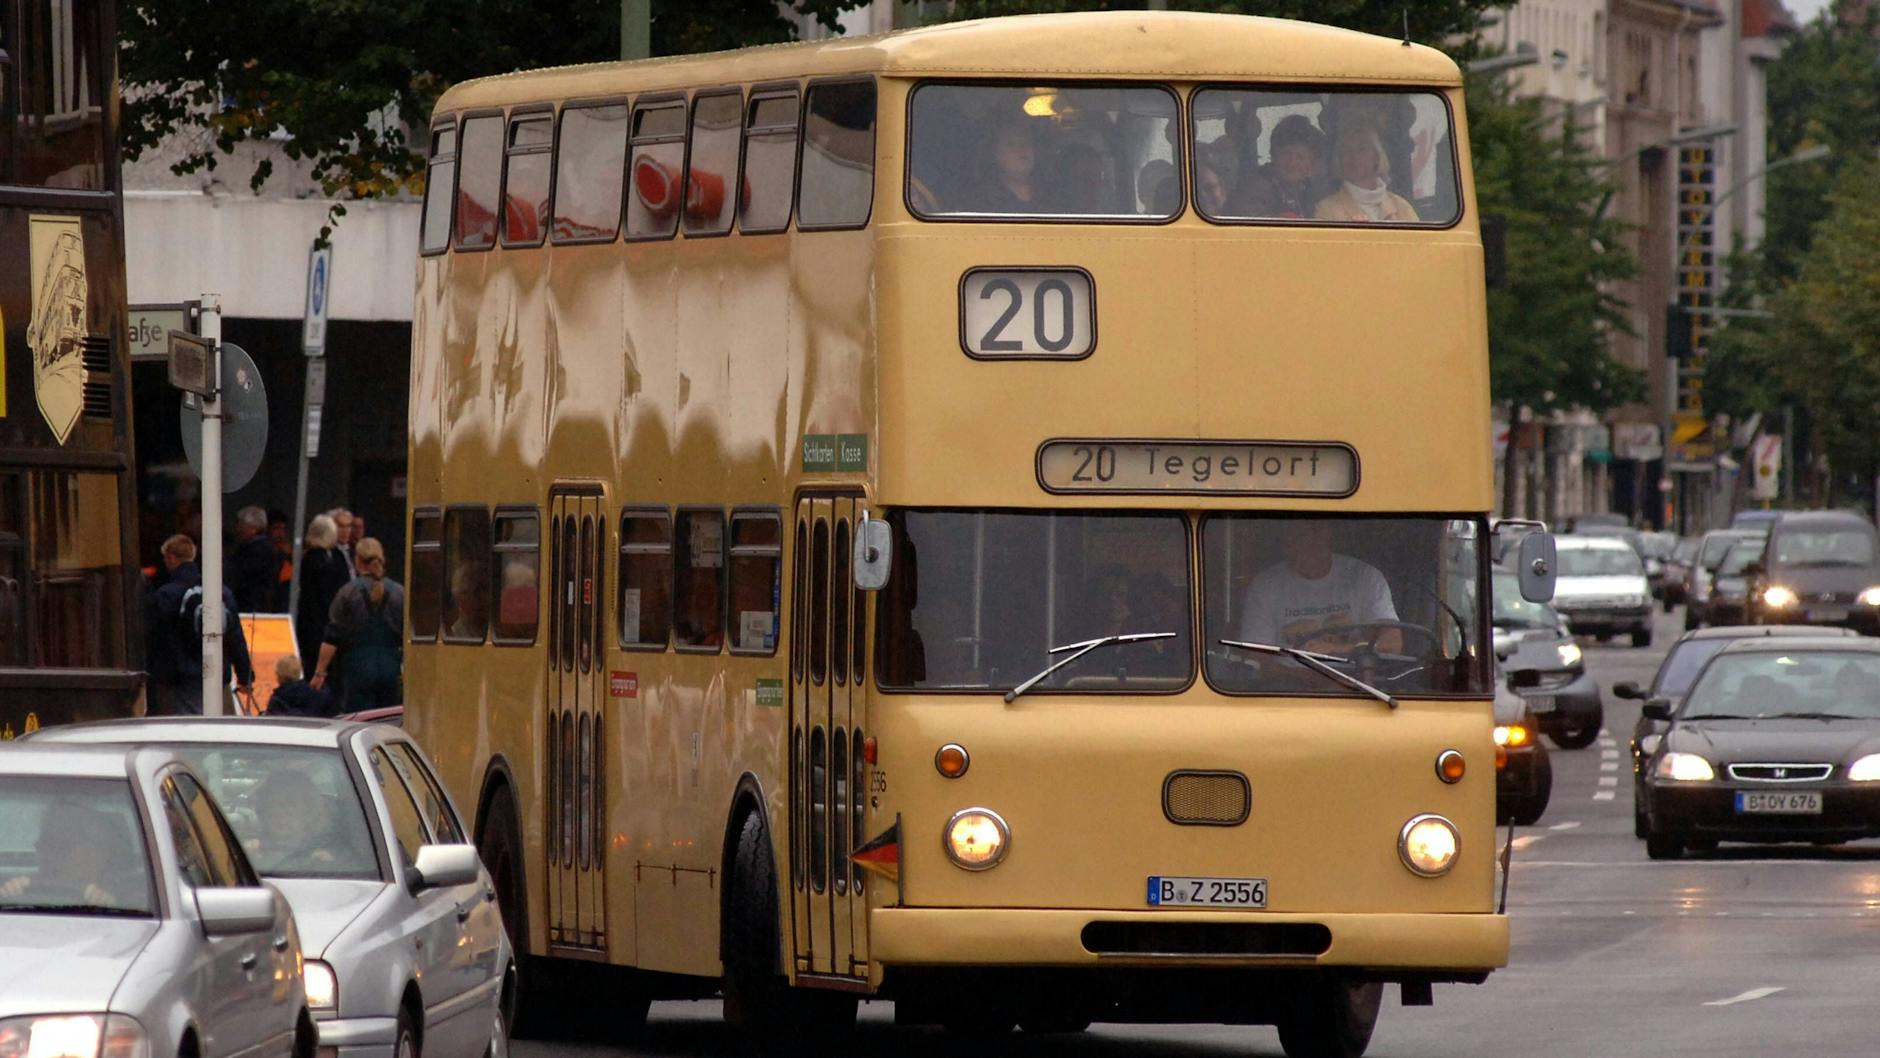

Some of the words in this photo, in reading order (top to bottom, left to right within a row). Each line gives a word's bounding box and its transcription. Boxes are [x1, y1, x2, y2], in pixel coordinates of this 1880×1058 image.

[979, 277, 1074, 353] 20
[1072, 446, 1116, 482] 20
[1145, 448, 1320, 482] Tegelort
[1749, 795, 1759, 809] B
[1790, 795, 1817, 809] 676
[1161, 880, 1174, 901] B
[1191, 881, 1204, 902] Z
[1210, 882, 1264, 903] 2556
